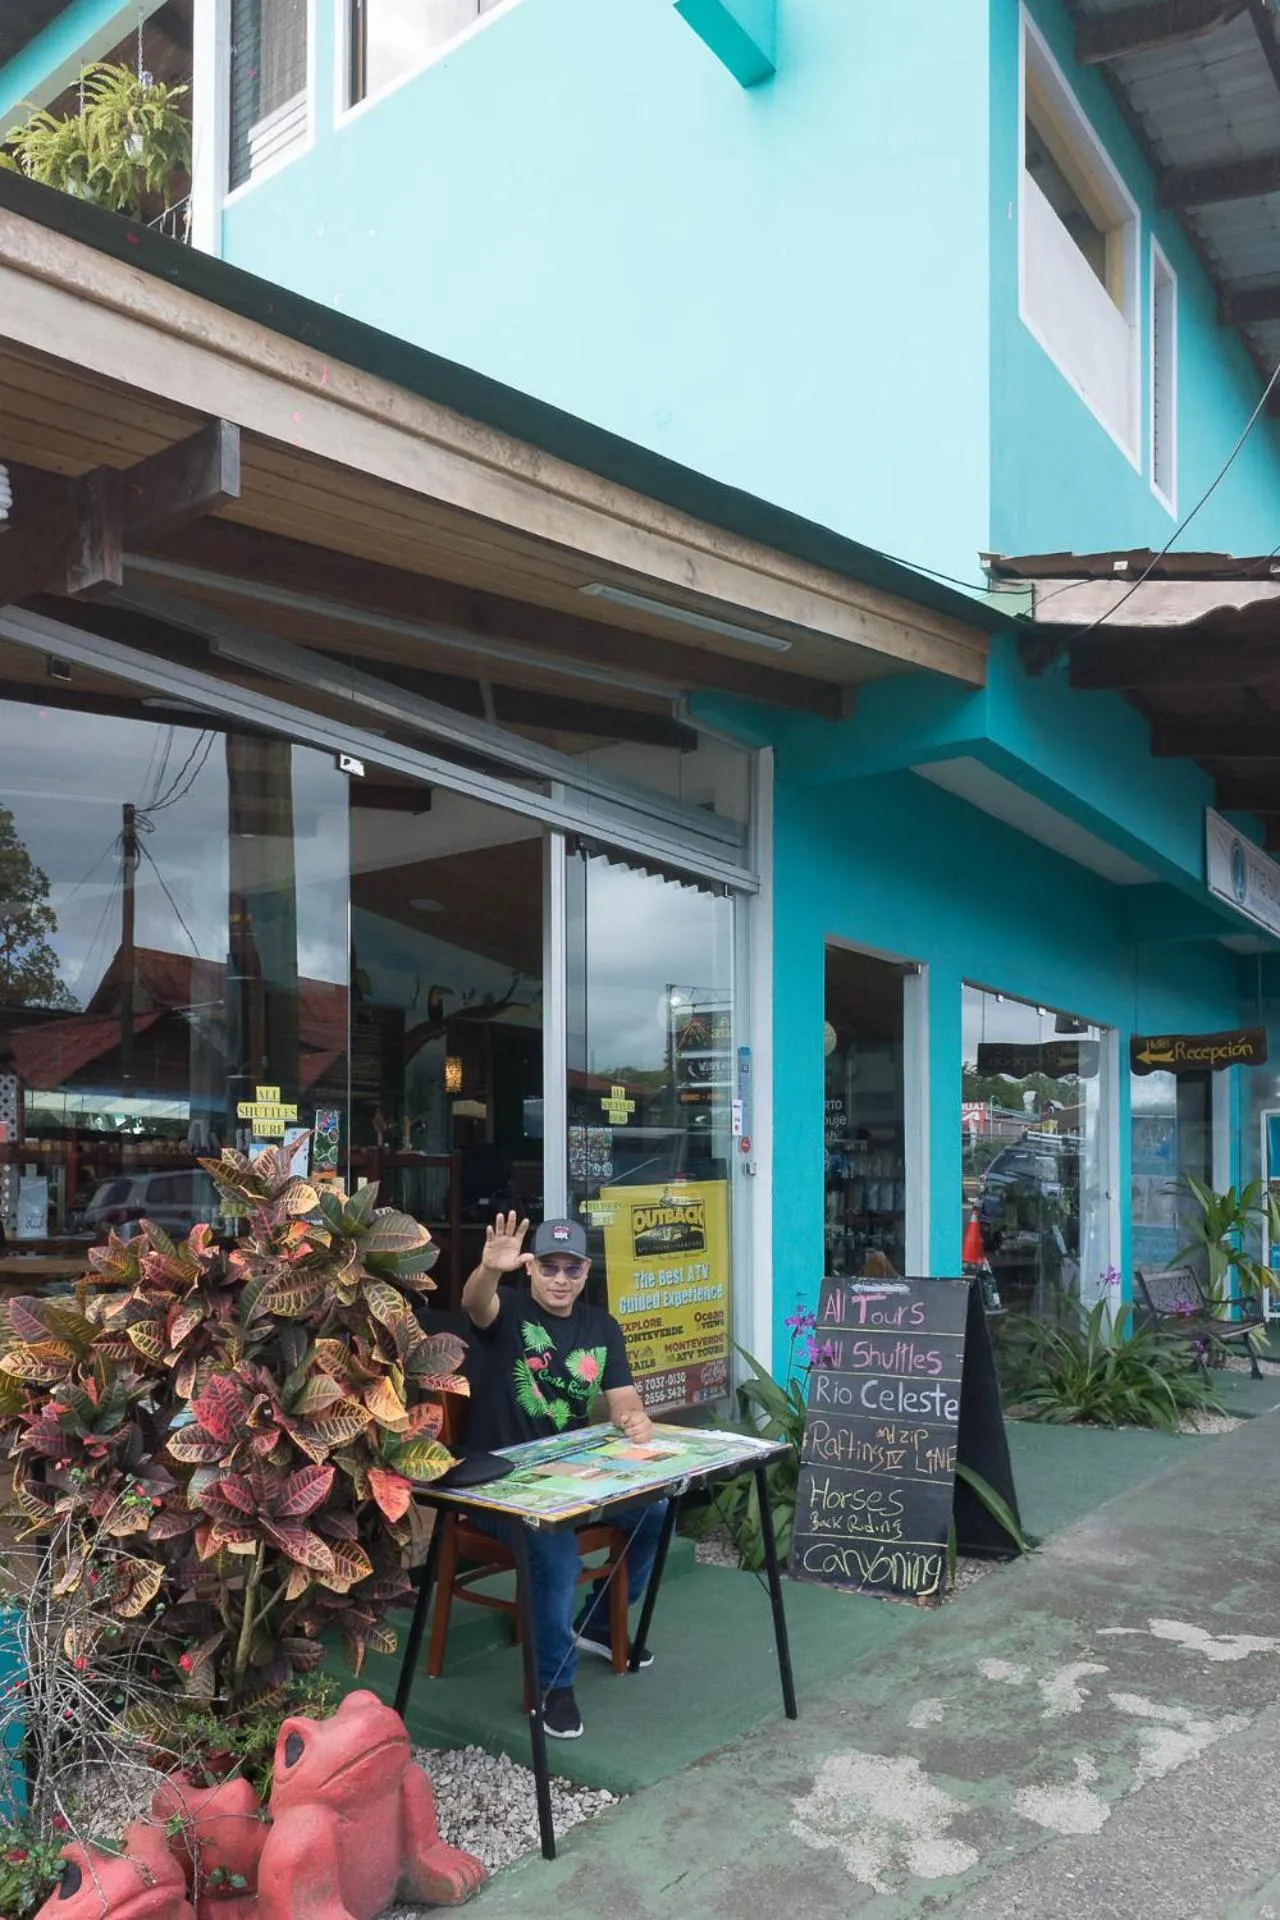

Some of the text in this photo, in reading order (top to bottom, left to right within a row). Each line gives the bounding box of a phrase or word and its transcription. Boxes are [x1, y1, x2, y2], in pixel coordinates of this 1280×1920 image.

[1174, 1036, 1253, 1065] Recepción
[633, 1269, 656, 1290] The
[823, 1288, 925, 1325] All Tours
[816, 1375, 959, 1421] Rio Celeste
[810, 1473, 905, 1517] Horses
